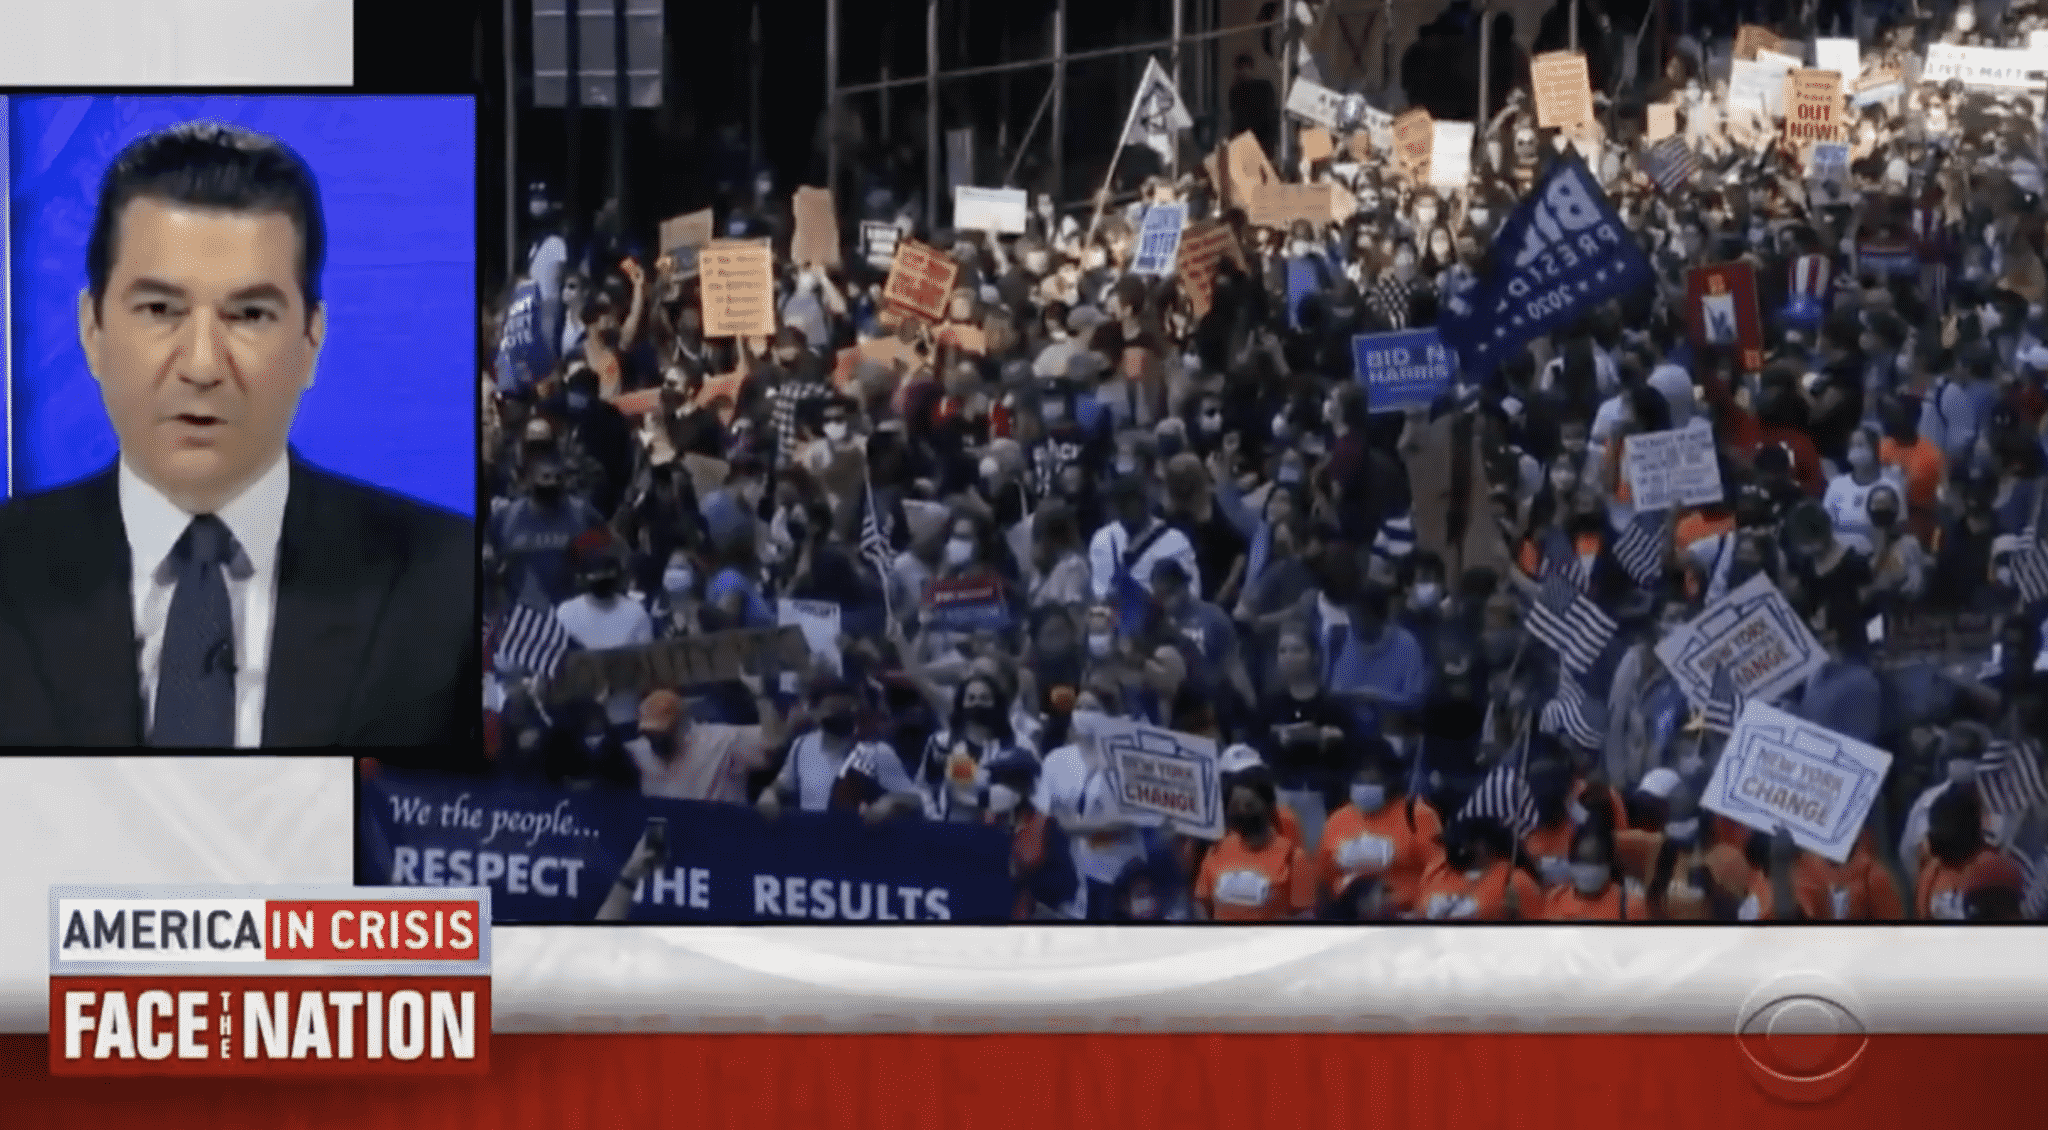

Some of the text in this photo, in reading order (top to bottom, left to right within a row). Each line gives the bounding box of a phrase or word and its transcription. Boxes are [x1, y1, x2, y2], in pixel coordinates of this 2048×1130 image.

[1797, 103, 1831, 121] OUT
[1790, 122, 1838, 140] NOW!
[1367, 344, 1446, 368] BIDN
[1370, 363, 1448, 383] HARRIS
[1733, 616, 1772, 646] YORK
[1159, 762, 1194, 782] YORK
[1754, 746, 1797, 774] NEW
[1801, 763, 1845, 792] YORK
[390, 793, 431, 827] We
[441, 791, 483, 830] the
[1125, 783, 1196, 811] CHANGE
[1742, 776, 1829, 829] CHANGE
[391, 846, 951, 921] RESPECT HE RESULTS
